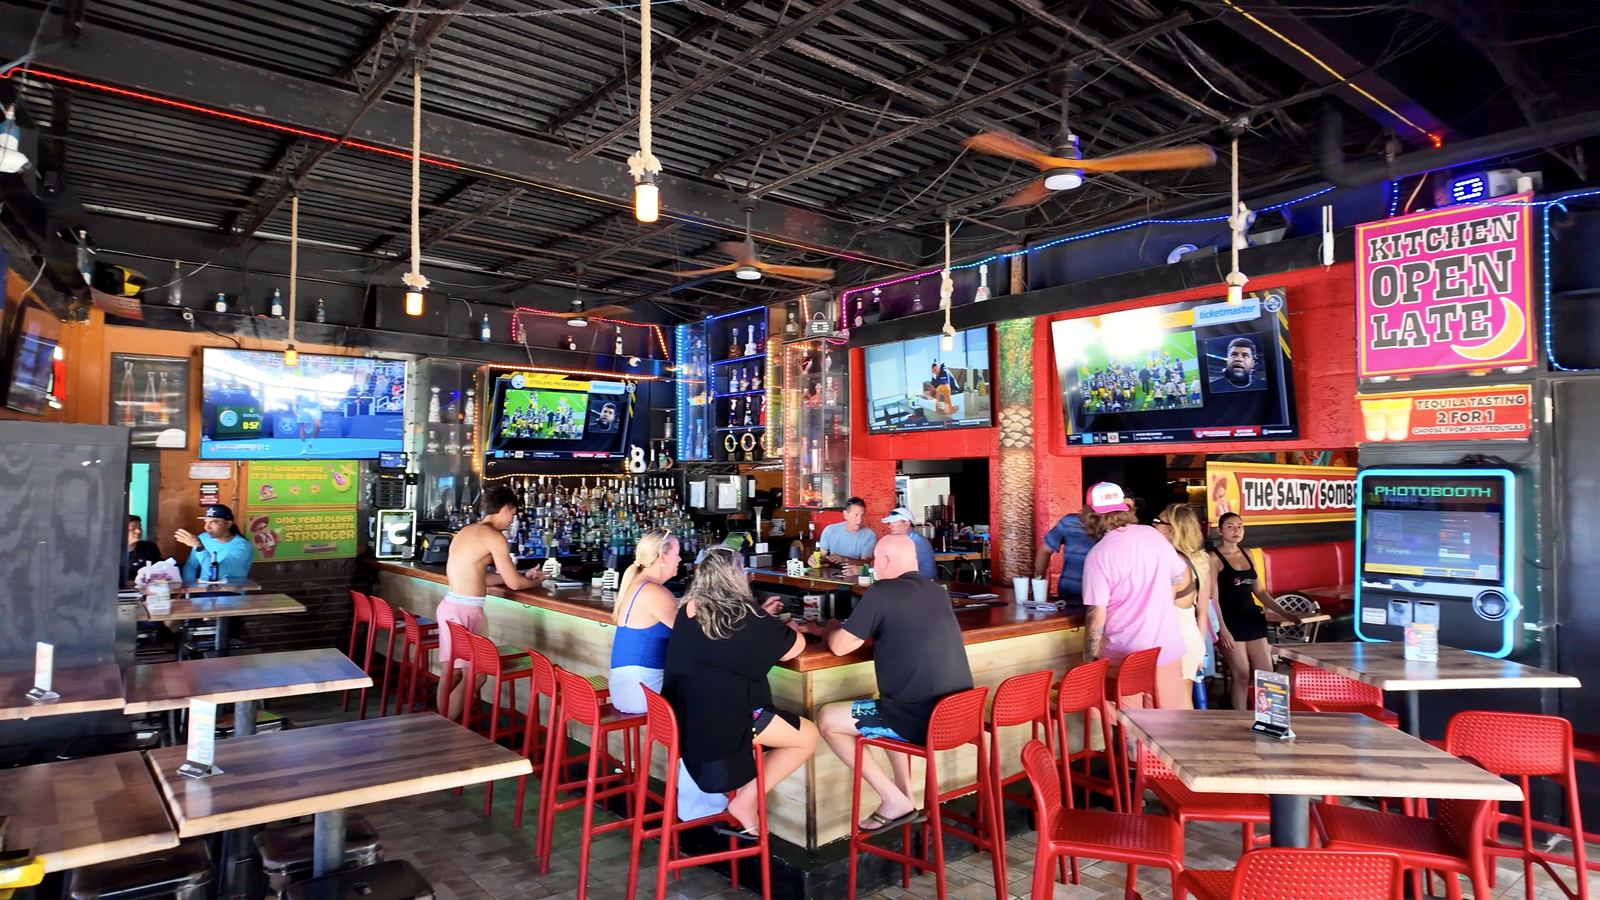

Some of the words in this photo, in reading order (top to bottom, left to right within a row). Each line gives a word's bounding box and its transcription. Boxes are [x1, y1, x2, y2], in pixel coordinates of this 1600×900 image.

[1369, 213, 1518, 262] KITCHEN
[1371, 249, 1514, 307] OPEN
[1199, 304, 1256, 319] ticketmaster
[1372, 301, 1491, 348] LATE
[1417, 399, 1467, 410] TEQUILA
[1470, 395, 1525, 407] TASTING
[1437, 411, 1447, 424] 2
[1450, 410, 1483, 423] FOR
[1486, 410, 1494, 422] 1
[1276, 481, 1316, 506] SALTY
[1374, 485, 1492, 498] PHOTOBOOTH
